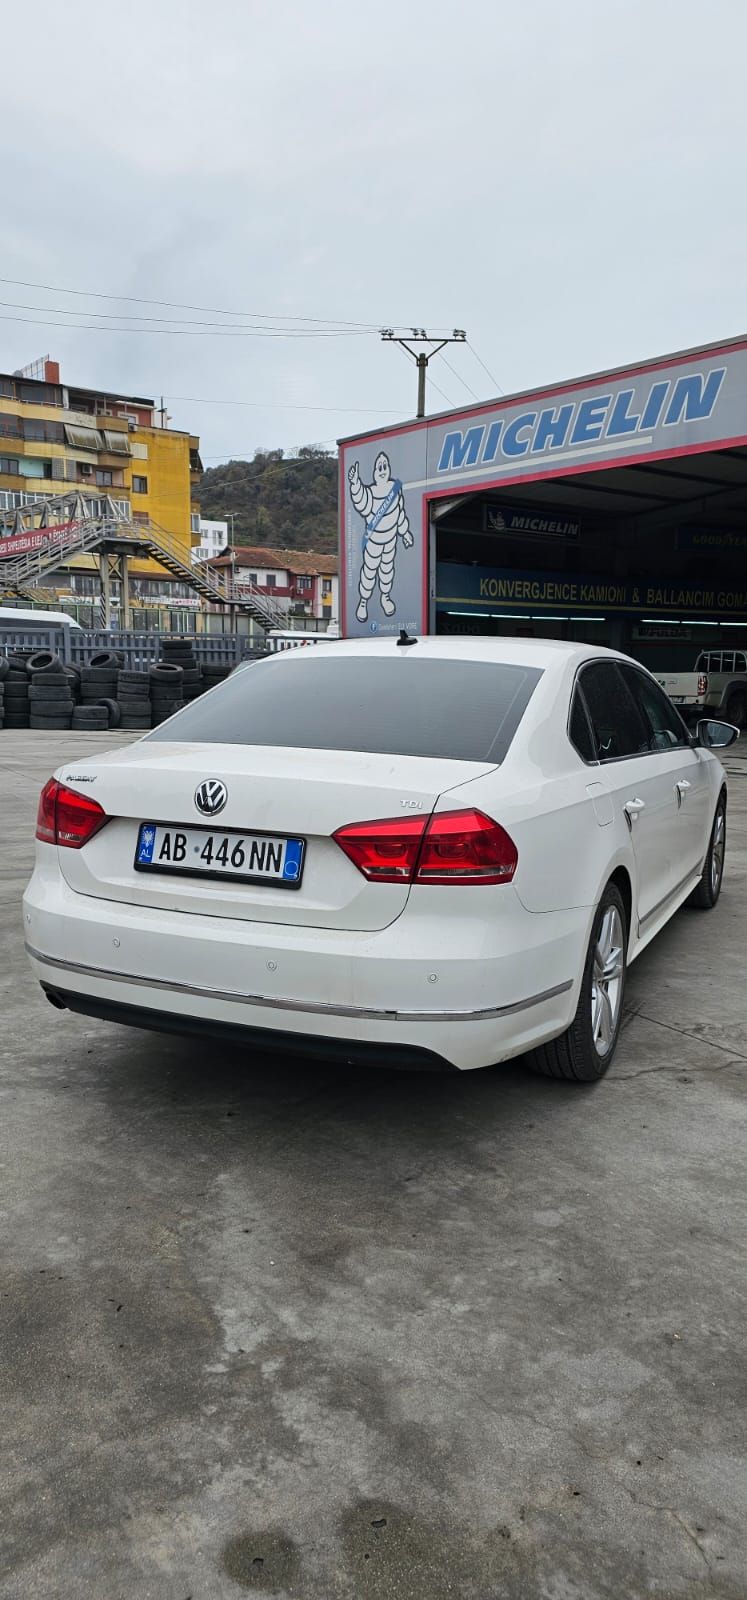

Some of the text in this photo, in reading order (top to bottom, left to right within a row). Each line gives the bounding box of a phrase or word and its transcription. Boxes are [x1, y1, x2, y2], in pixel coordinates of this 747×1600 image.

[437, 367, 727, 472] MICHELIN
[510, 515, 579, 536] MICHELIN
[480, 578, 577, 601] KONVERGJENCE
[580, 585, 626, 602] KAMIONI
[632, 587, 640, 603] &
[647, 588, 714, 608] BALLANCIM
[400, 799, 423, 809] TDI
[140, 849, 151, 858] AL
[158, 833, 283, 873] AB 446 NN
